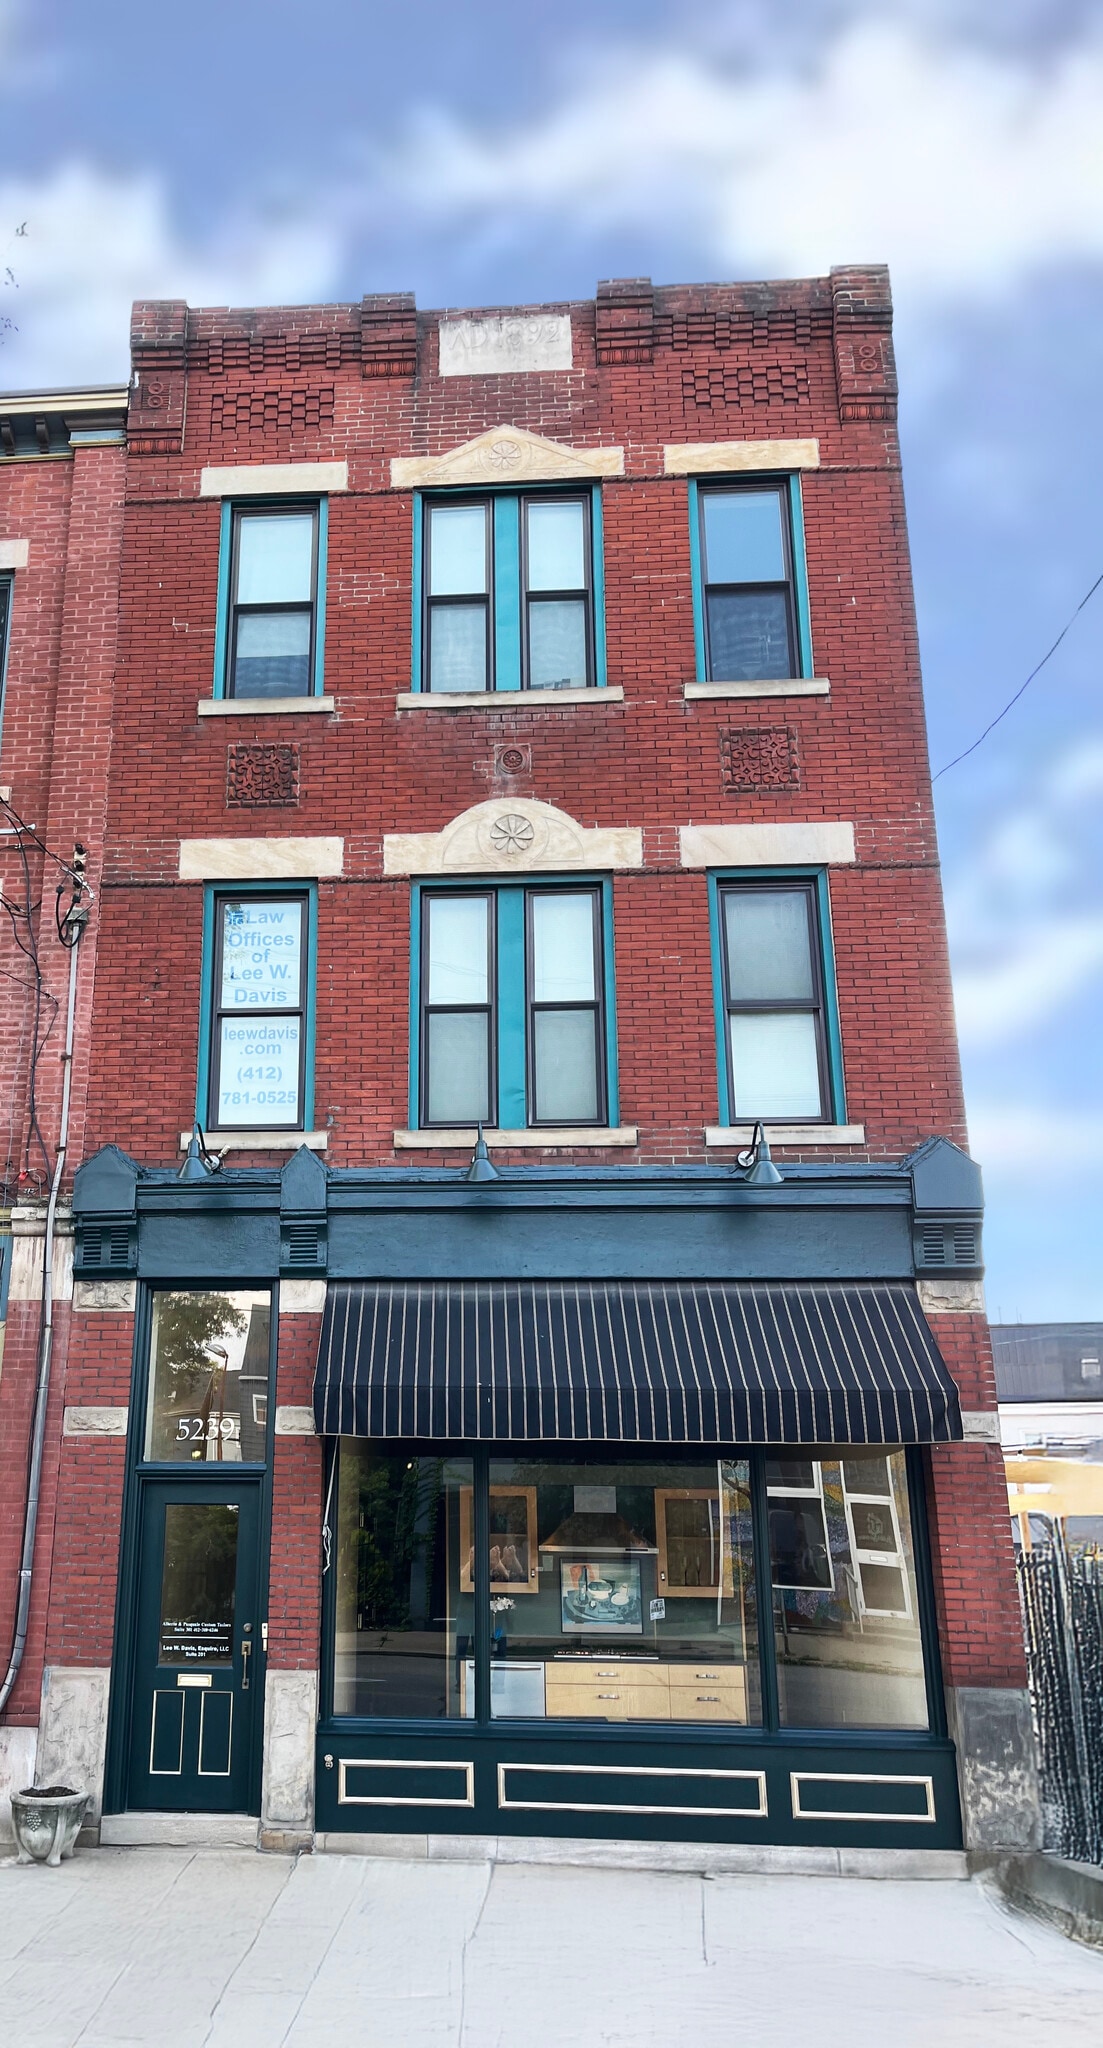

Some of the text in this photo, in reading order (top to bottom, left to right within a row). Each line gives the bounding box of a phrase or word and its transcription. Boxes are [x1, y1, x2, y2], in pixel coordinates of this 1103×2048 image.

[247, 910, 284, 924] Law
[229, 931, 295, 947] Offices
[251, 949, 271, 963] of
[230, 964, 291, 980] Lee W.
[234, 987, 287, 1003] Davis
[224, 1026, 298, 1040] leewdavis
[240, 1042, 281, 1055] .com
[237, 1066, 282, 1082] (412)
[222, 1090, 297, 1104] 781-0525
[175, 1417, 235, 1441] 5239
